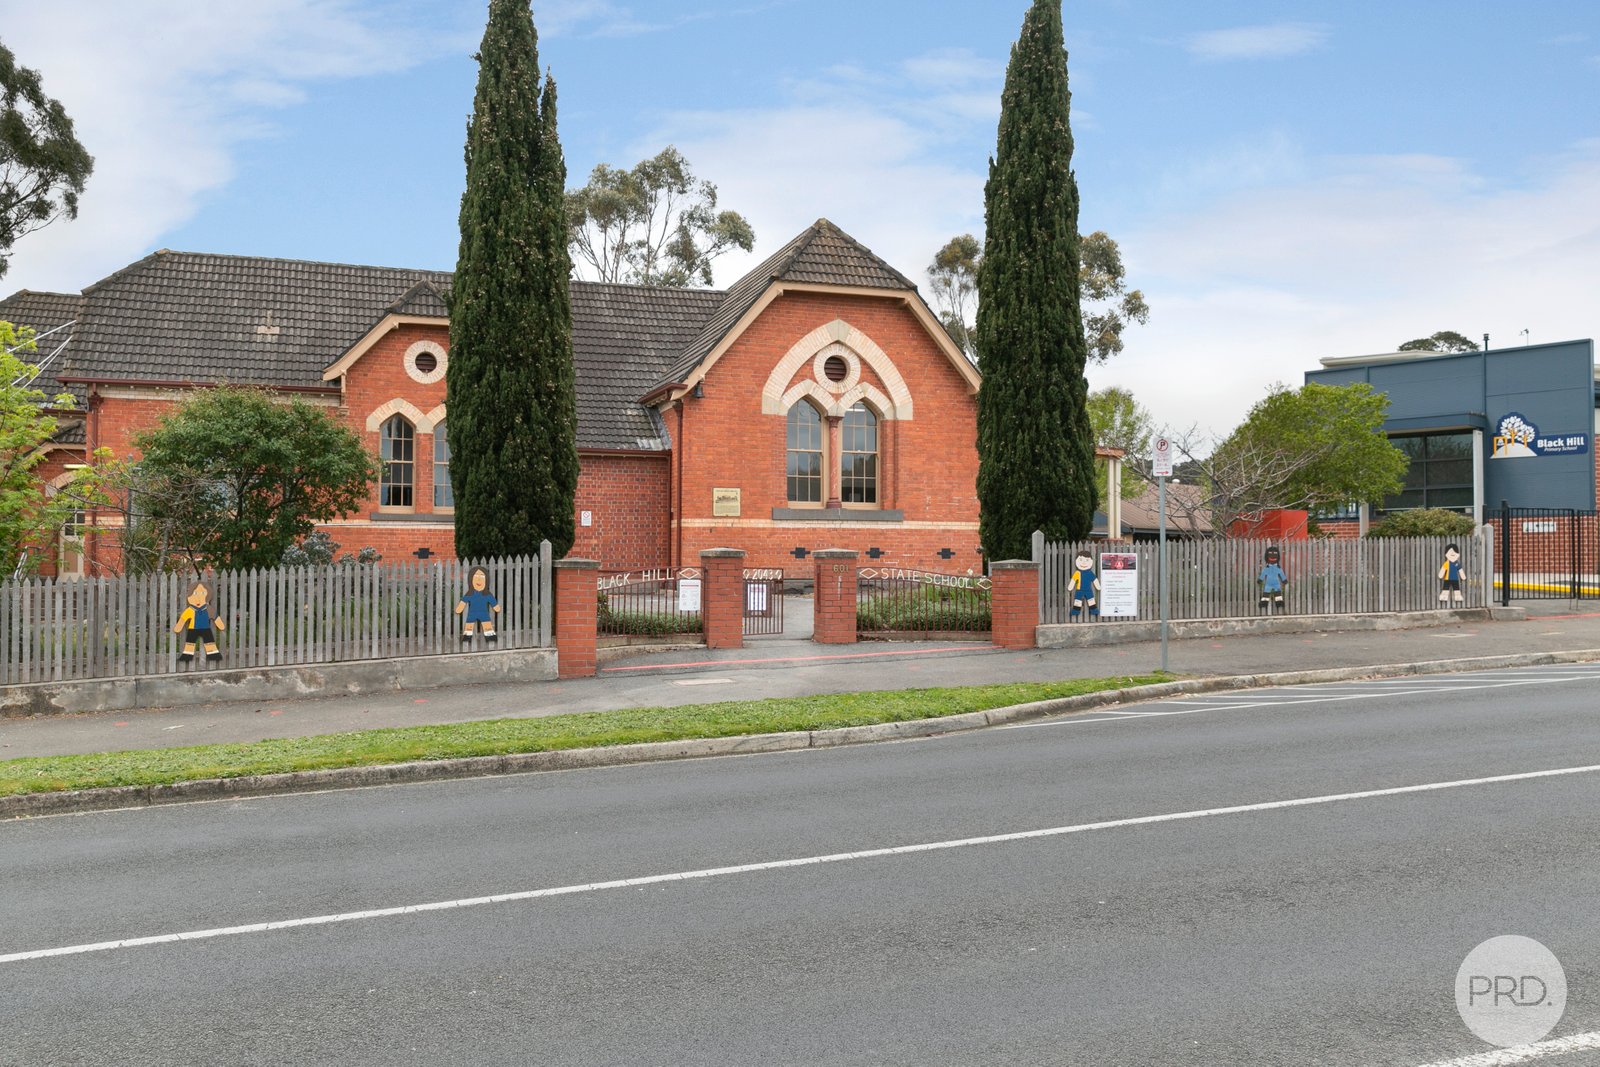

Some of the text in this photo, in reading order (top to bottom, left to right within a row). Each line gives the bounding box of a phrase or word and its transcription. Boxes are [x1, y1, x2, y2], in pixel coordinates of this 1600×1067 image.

[1537, 436, 1585, 448] Black Hill
[752, 568, 774, 580] 2043
[833, 564, 849, 573] 601
[597, 567, 674, 590] BLACK HILL
[880, 567, 974, 589] STATE SCHOOL
